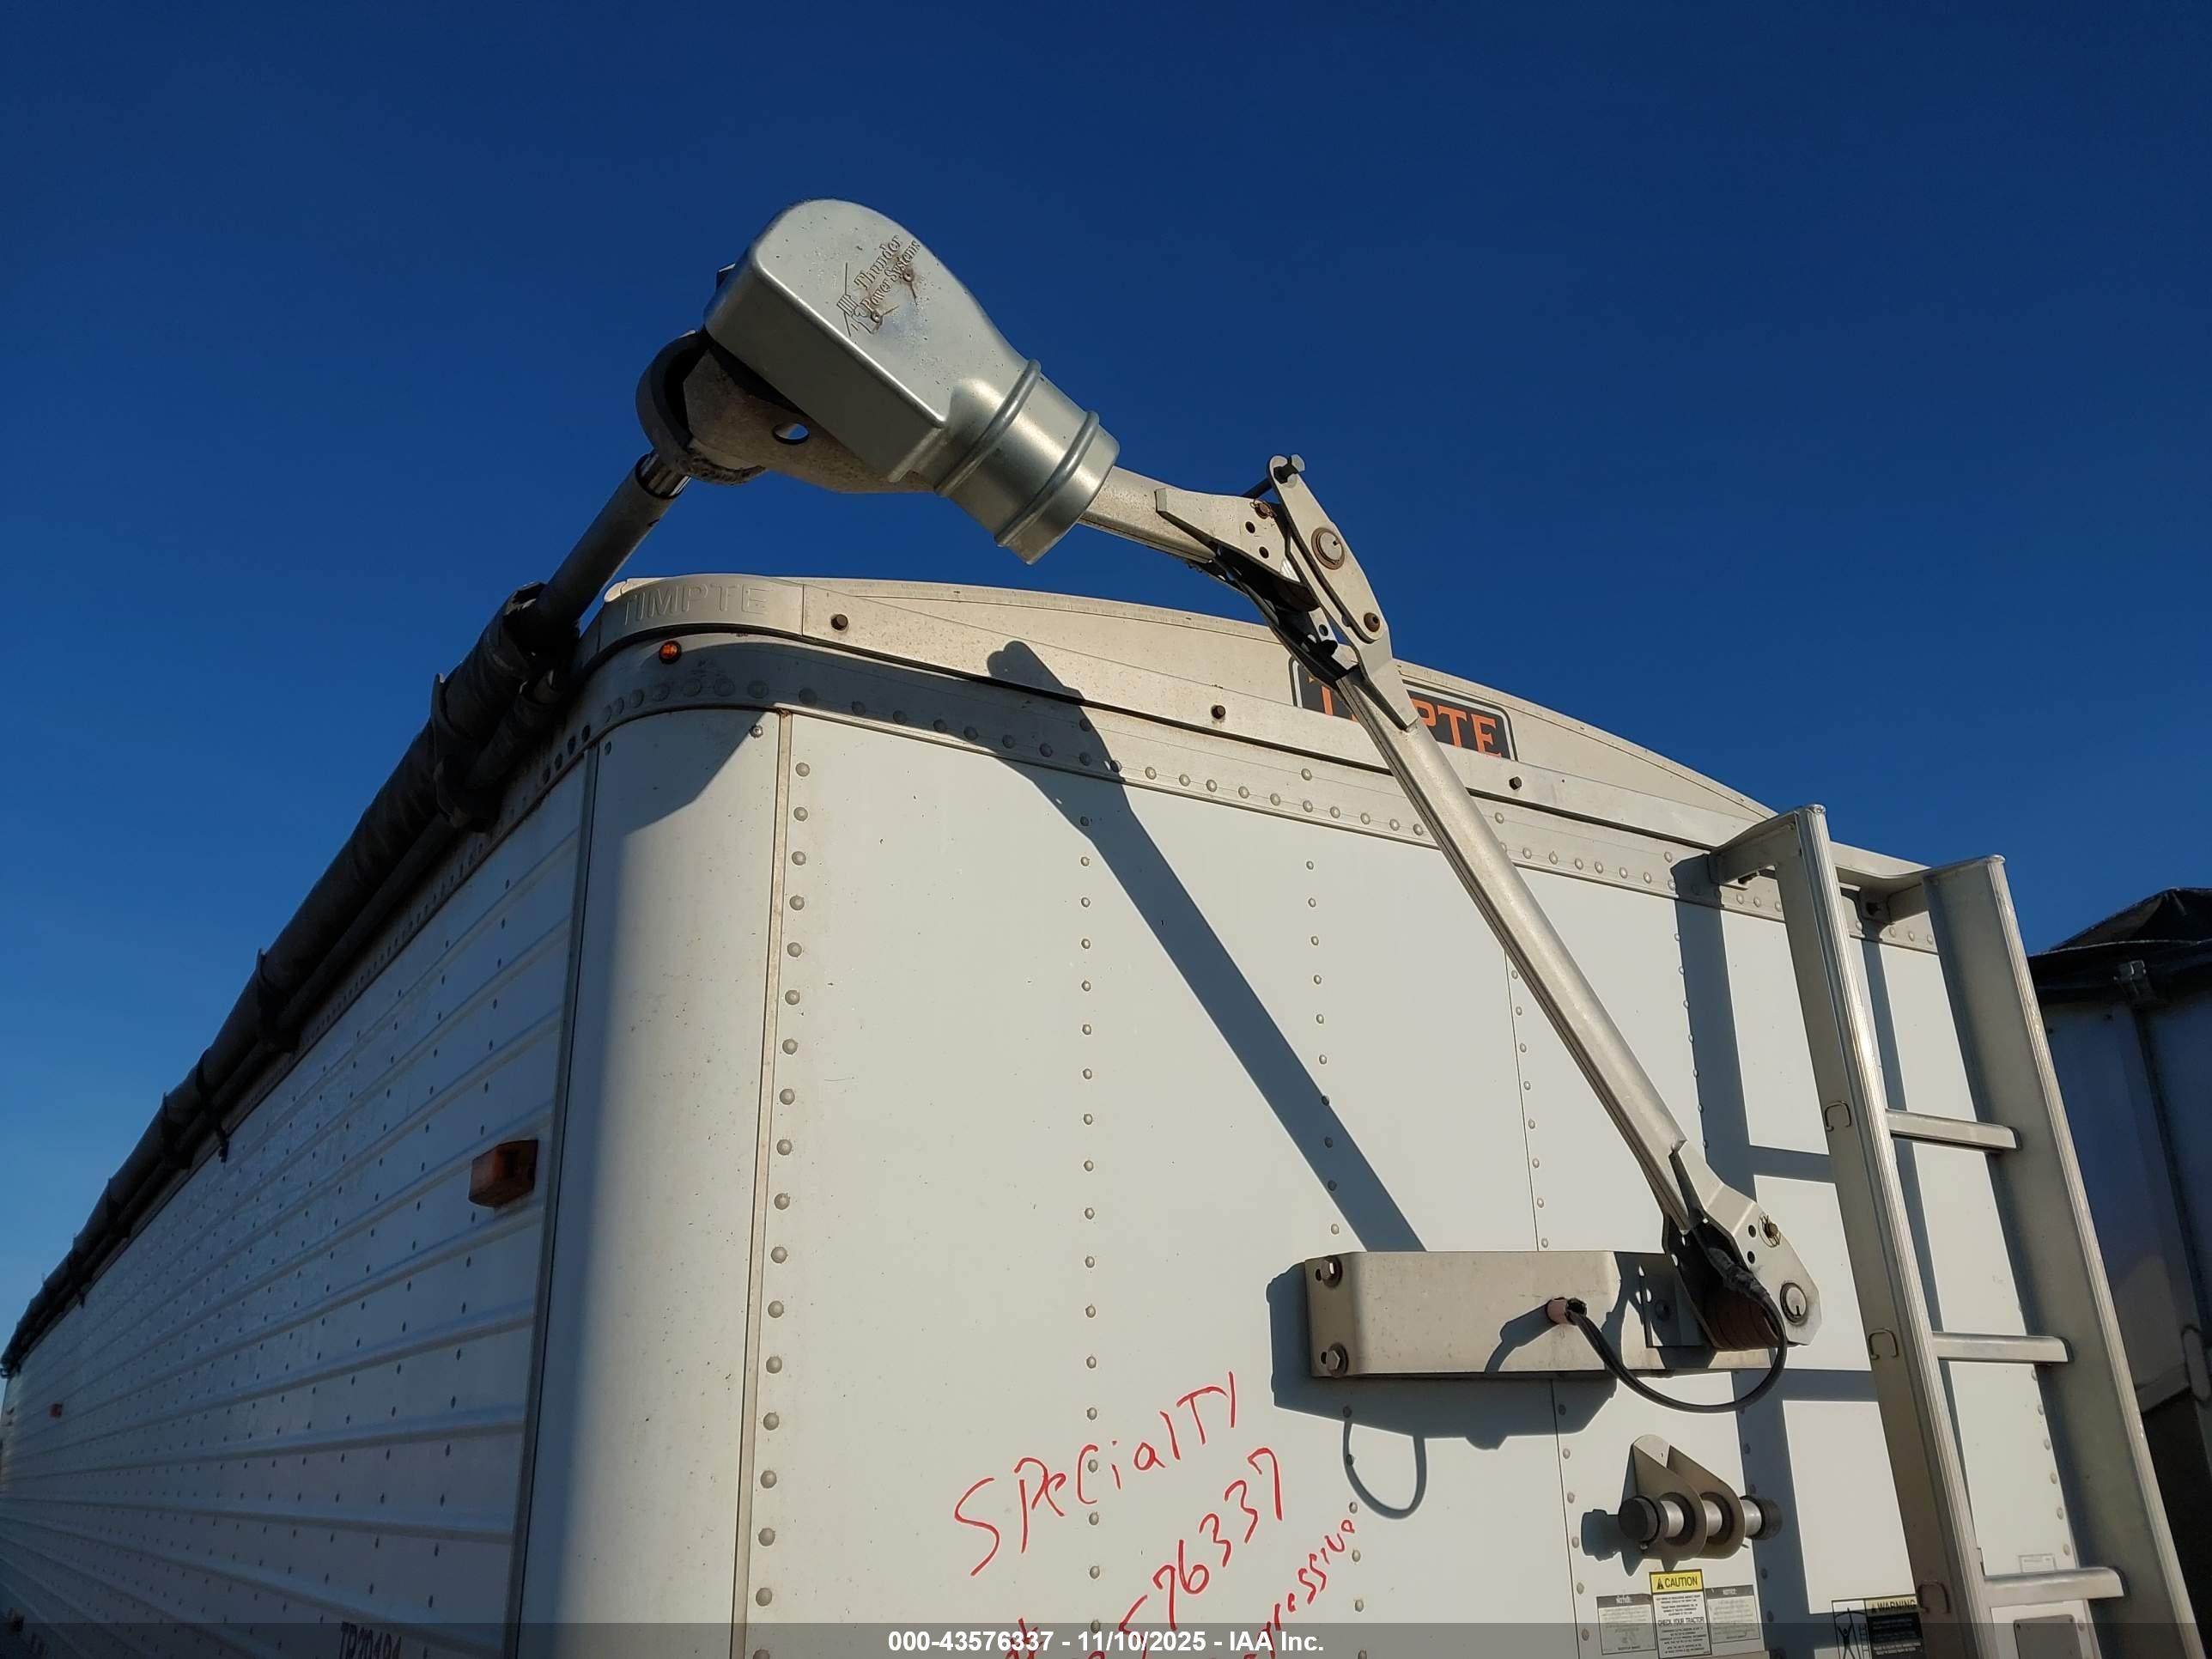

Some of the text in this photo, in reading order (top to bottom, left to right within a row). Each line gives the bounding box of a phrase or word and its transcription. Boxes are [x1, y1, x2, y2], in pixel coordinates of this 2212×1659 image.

[853, 234, 902, 290] Thunder
[860, 239, 921, 313] Power Systems
[620, 583, 771, 626] TIMPTE
[1664, 1575, 1698, 1589] CAUTION
[1877, 1599, 1917, 1612] WARNING
